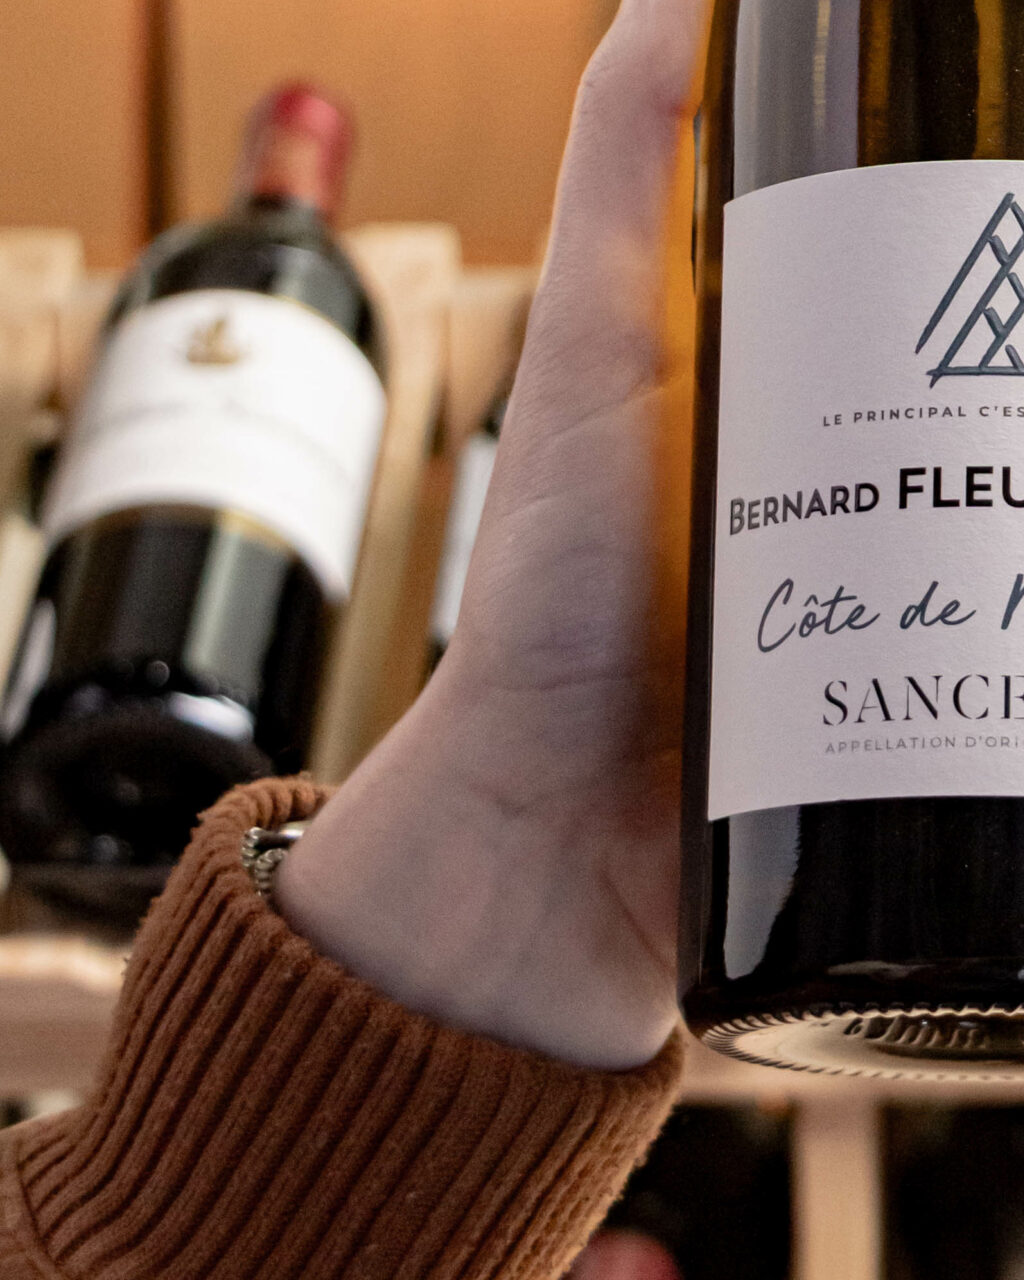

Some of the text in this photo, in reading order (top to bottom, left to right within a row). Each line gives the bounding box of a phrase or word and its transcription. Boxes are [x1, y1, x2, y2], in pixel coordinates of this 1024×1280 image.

[822, 414, 843, 427] LE
[853, 405, 968, 423] PRINCIPAL
[730, 483, 879, 535] BERNARD
[758, 578, 880, 653] Côte
[900, 581, 976, 630] de
[826, 736, 957, 753] APPELLATION
